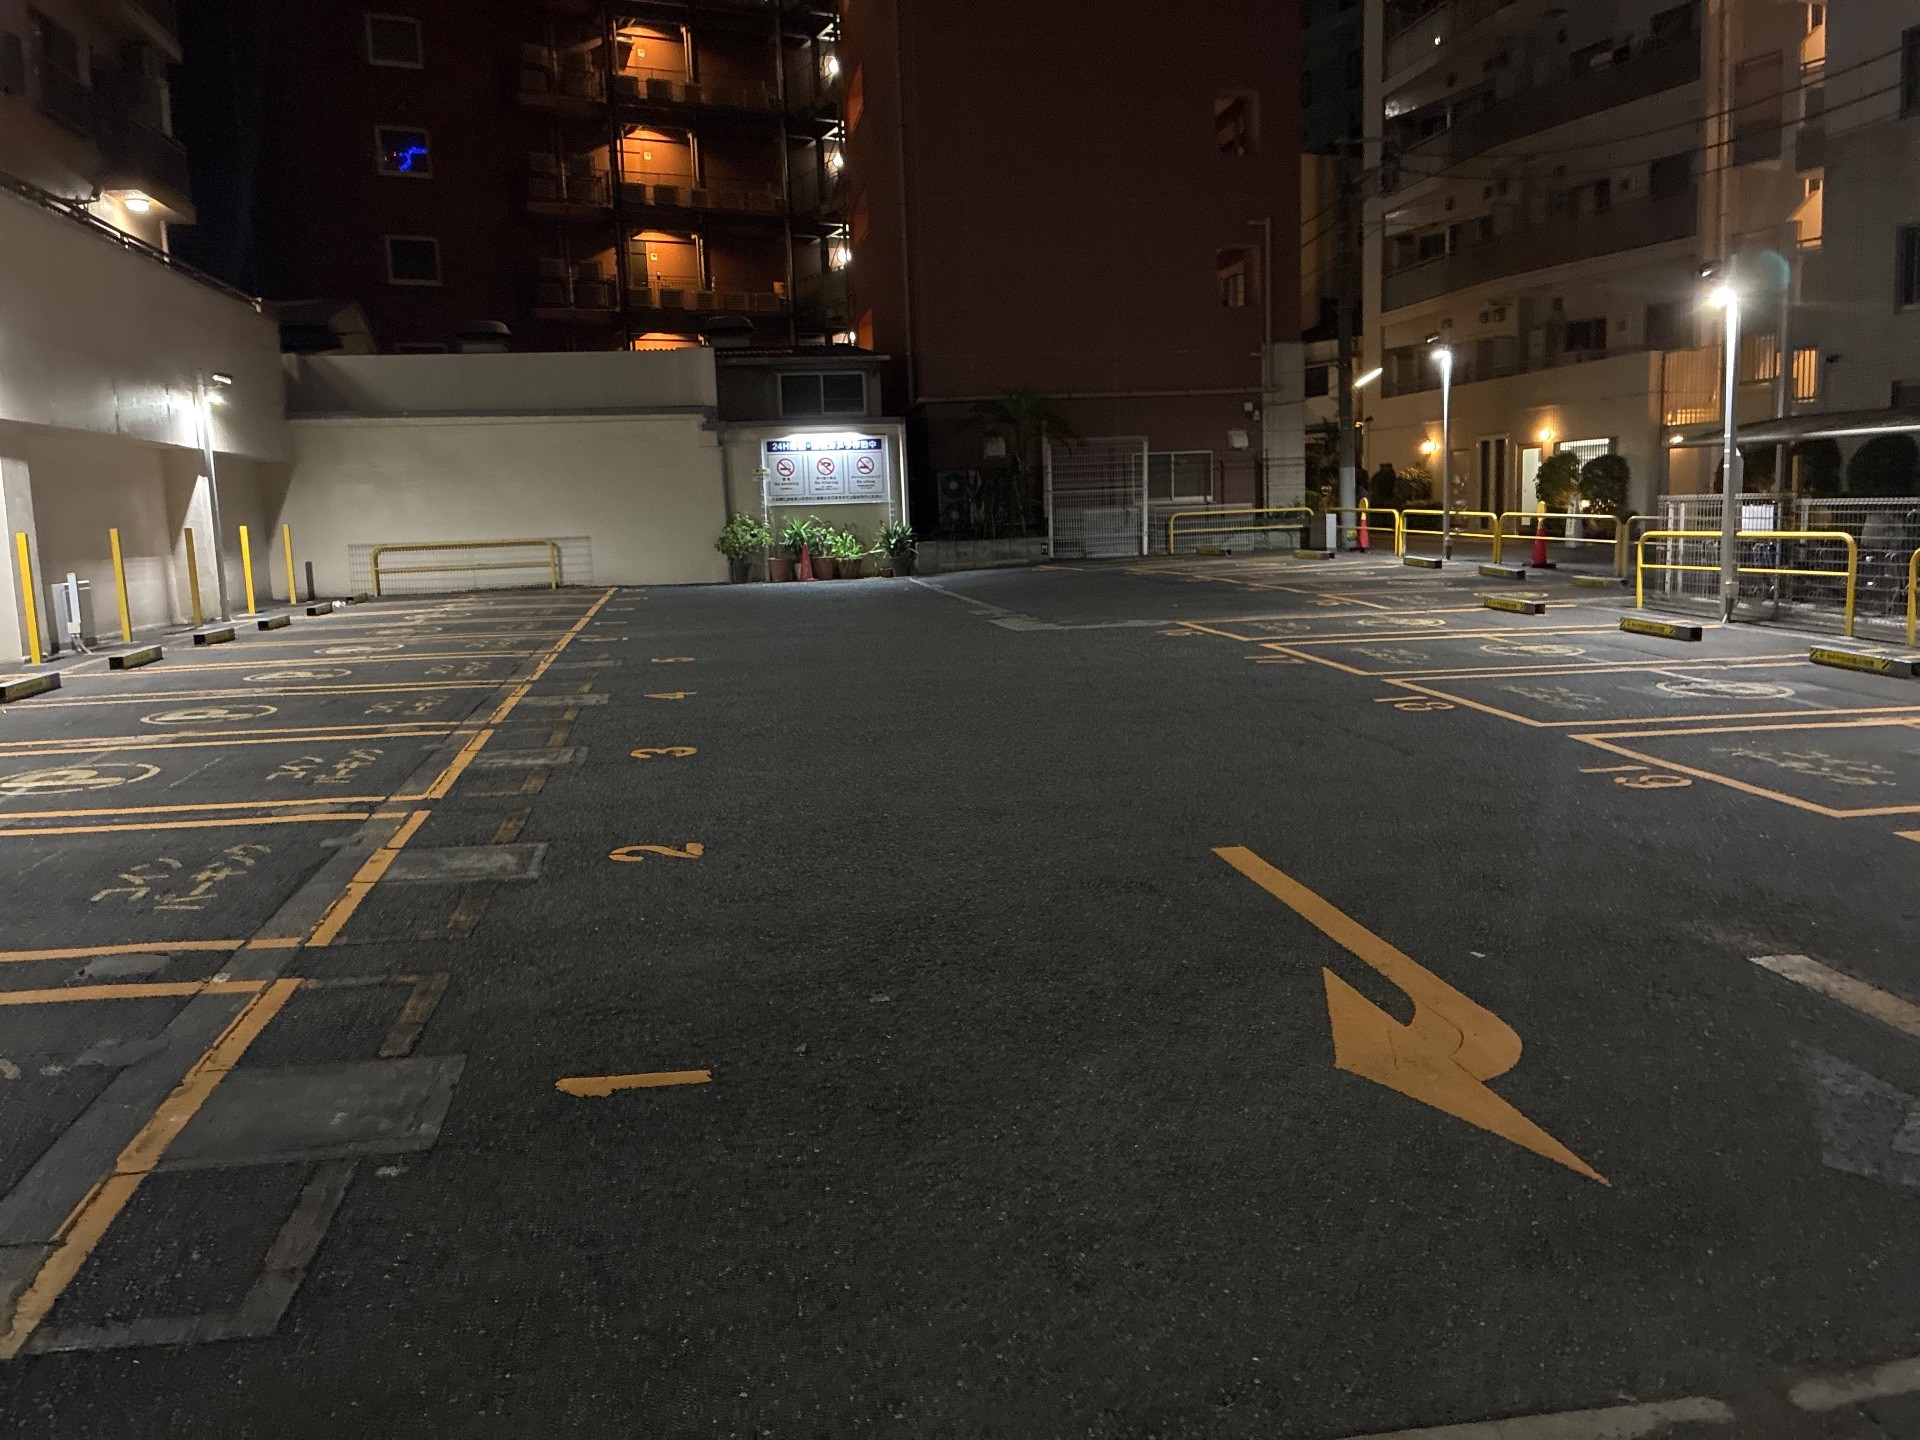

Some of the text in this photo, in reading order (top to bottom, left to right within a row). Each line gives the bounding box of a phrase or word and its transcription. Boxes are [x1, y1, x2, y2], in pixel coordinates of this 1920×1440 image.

[643, 691, 697, 700] 4
[1374, 694, 1456, 713] 18
[629, 746, 698, 759] 3
[1579, 764, 1694, 789] 19
[608, 842, 705, 863] 2
[90, 857, 182, 902] コイン
[153, 843, 272, 910] パーキング
[555, 1069, 712, 1098] 1
